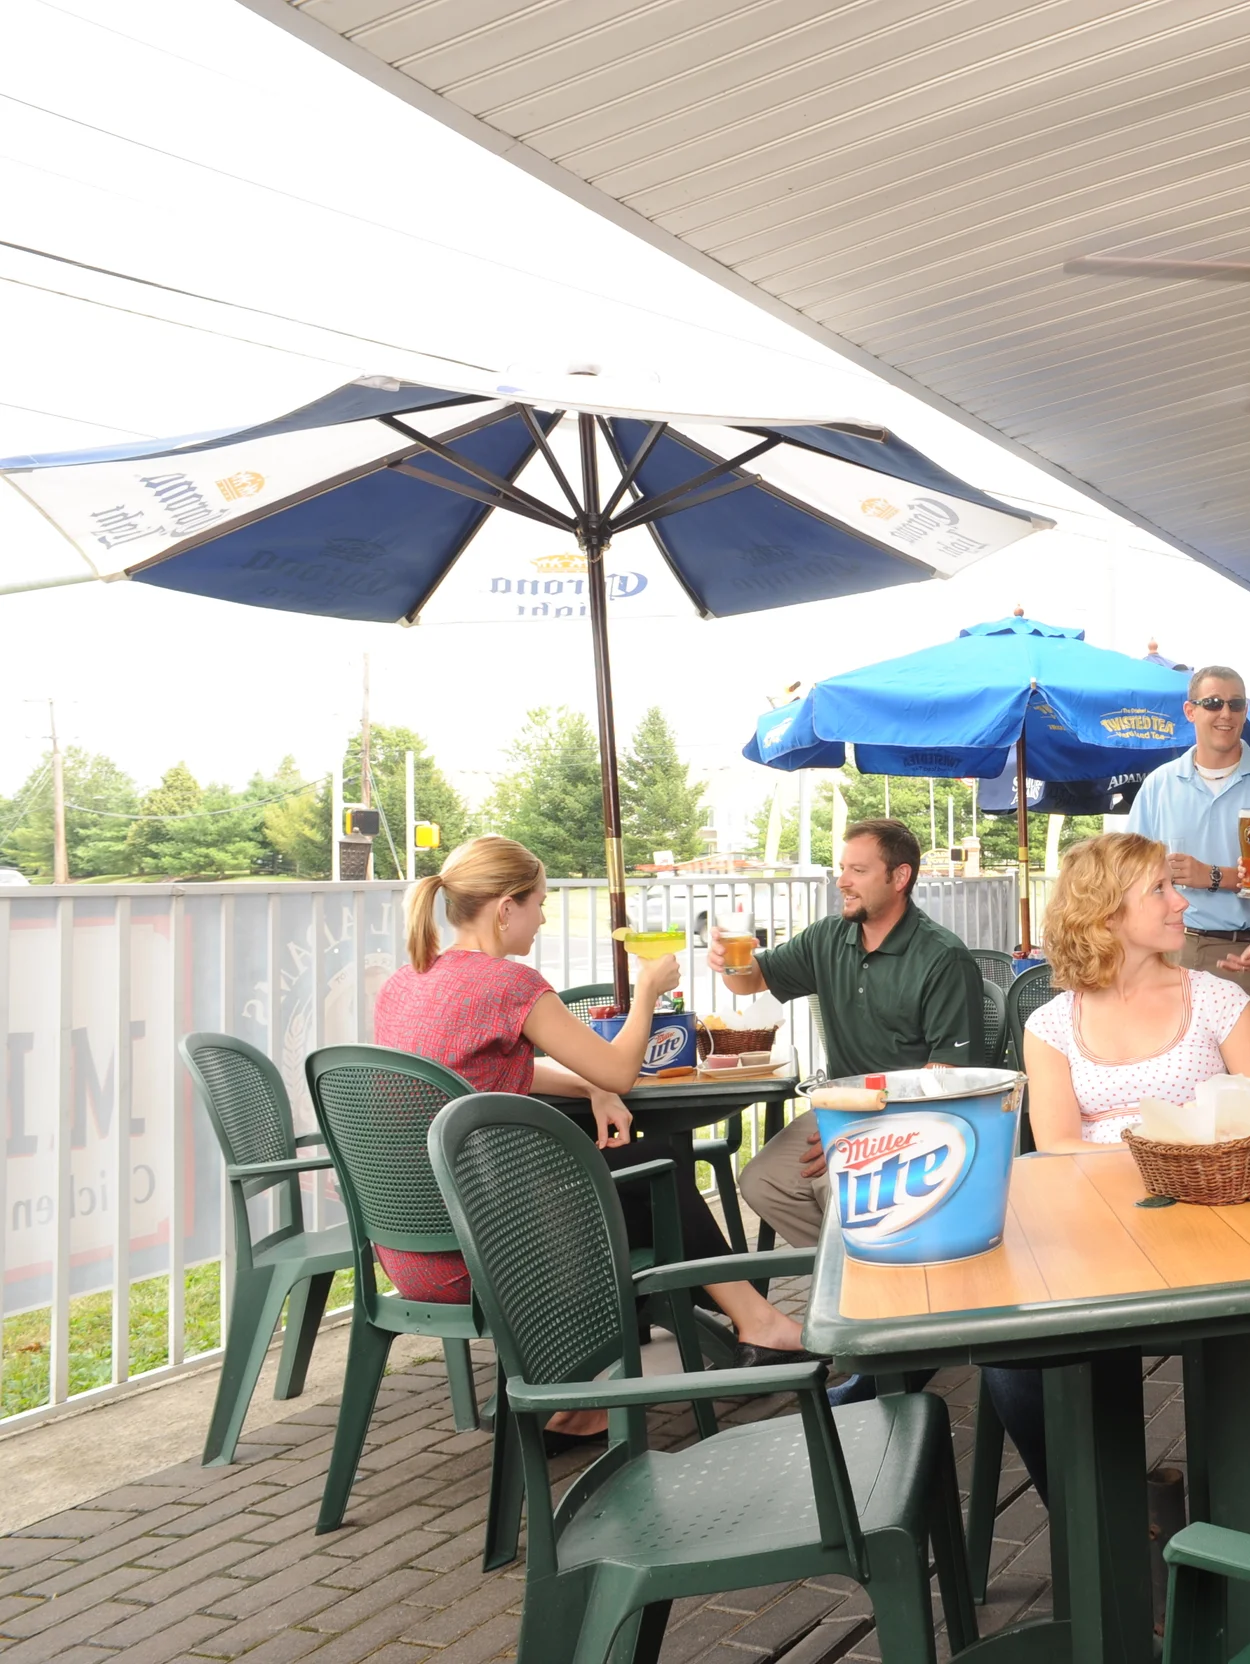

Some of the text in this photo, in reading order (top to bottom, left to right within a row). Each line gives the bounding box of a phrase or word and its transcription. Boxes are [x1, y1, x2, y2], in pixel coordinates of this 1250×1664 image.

[1100, 715, 1174, 735] TWISTED TEA
[1107, 772, 1149, 791] ADAM
[649, 1036, 680, 1064] Lite
[835, 1131, 920, 1166] Miller
[836, 1143, 949, 1229] Lite
